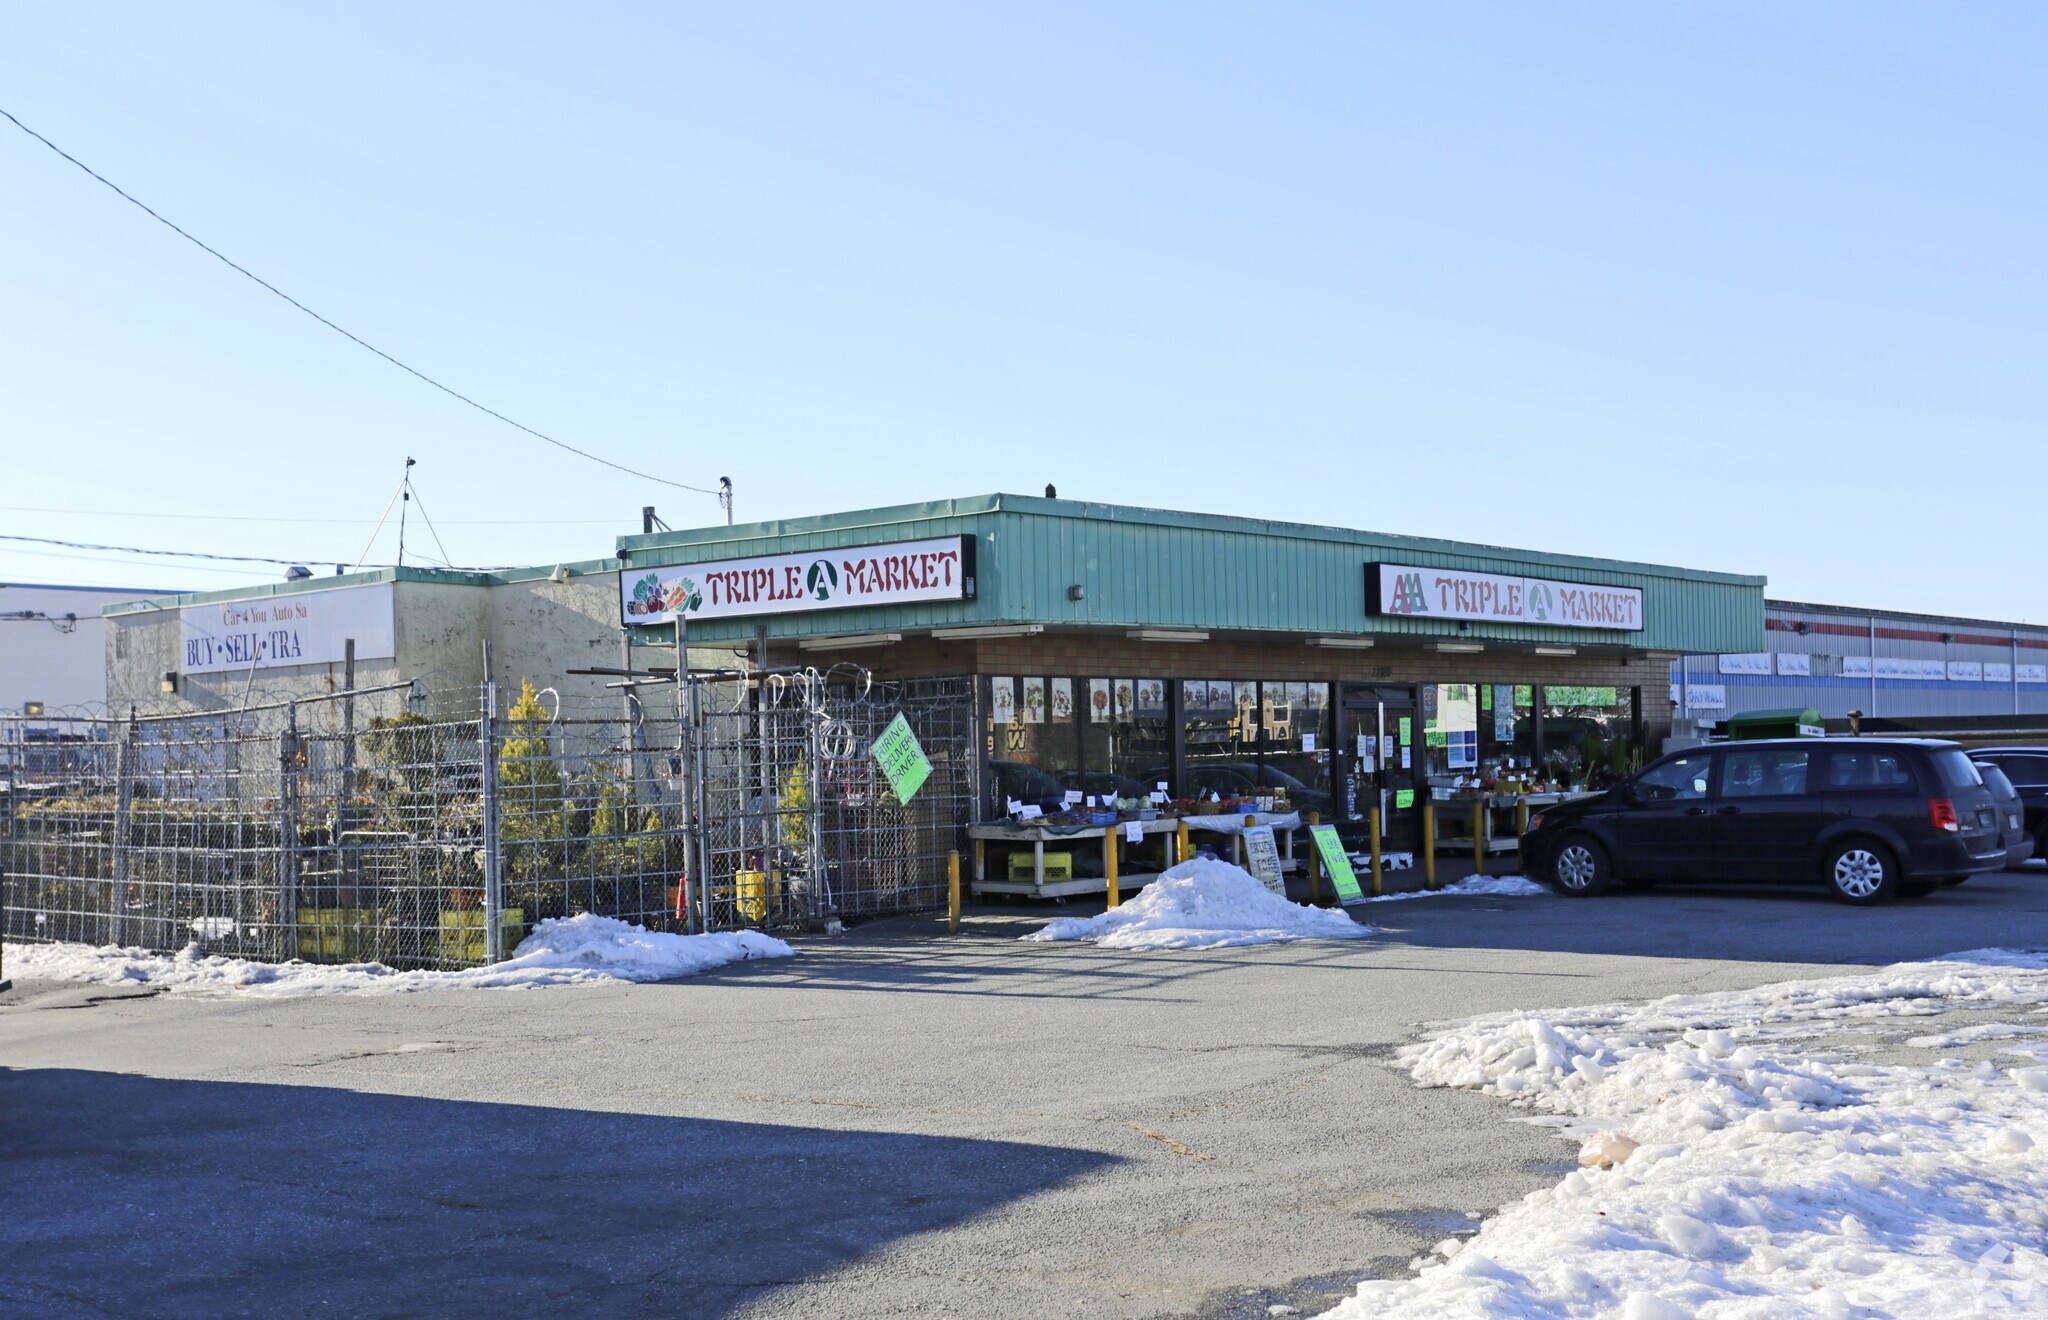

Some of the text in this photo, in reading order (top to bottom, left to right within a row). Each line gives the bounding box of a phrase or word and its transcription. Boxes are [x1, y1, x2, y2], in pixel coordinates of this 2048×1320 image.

[705, 550, 958, 606] TRIPLE A MARKET
[223, 602, 307, 627] Car 4 You Auto Sa
[1435, 576, 1523, 616] TRIPLE
[1529, 582, 1553, 621] A
[1559, 588, 1637, 624] MARKET
[187, 629, 302, 667] BUY SELL TRA
[876, 721, 906, 759] HIRING
[883, 732, 913, 773] DELIVERY
[890, 750, 920, 787] DRIVER
